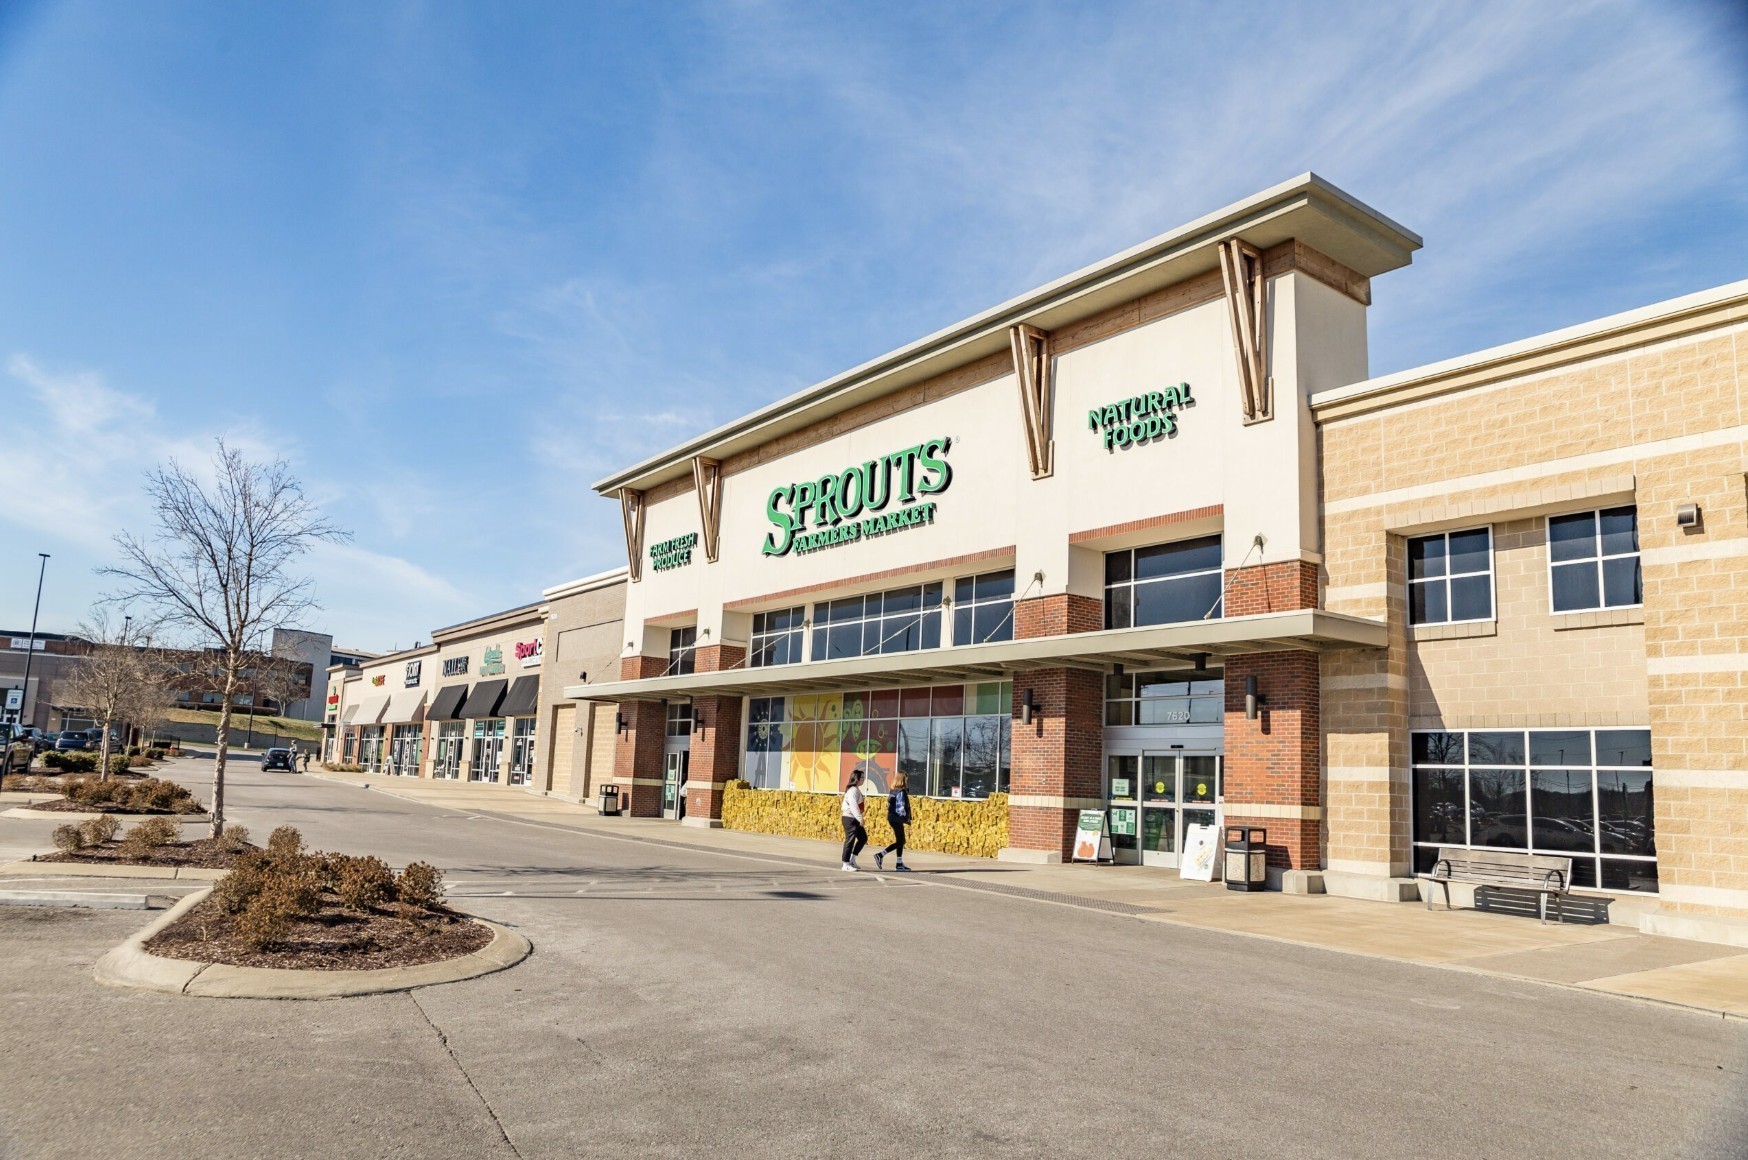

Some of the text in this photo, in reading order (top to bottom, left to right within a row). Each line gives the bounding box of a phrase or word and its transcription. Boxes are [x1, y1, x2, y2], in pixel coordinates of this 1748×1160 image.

[1088, 382, 1193, 431] NATURAL
[1104, 412, 1176, 451] FOODS
[762, 437, 952, 556] SPROUTS
[650, 532, 697, 557] FARM FRESH
[793, 502, 936, 554] FARMERS MARKET
[653, 549, 691, 570] PRODUCE
[1166, 711, 1191, 721] 7620
